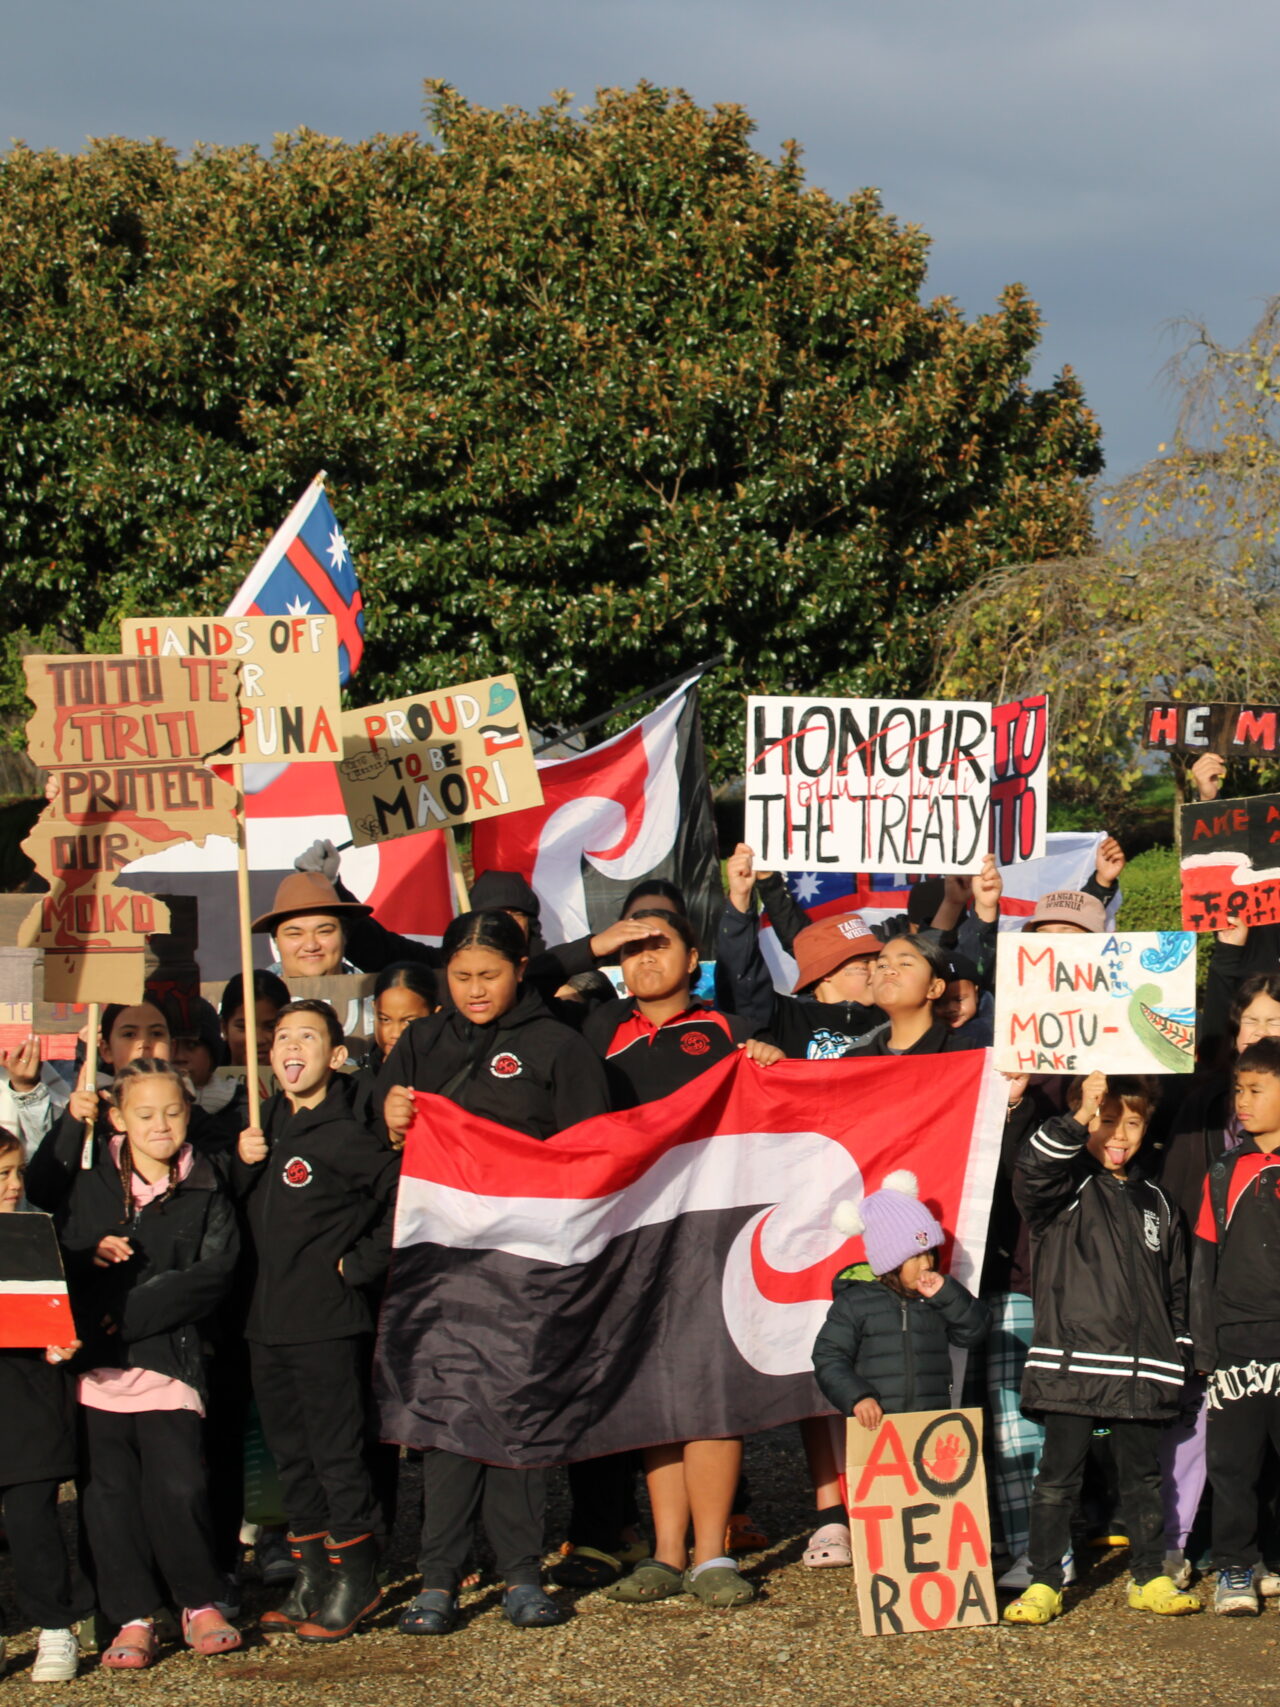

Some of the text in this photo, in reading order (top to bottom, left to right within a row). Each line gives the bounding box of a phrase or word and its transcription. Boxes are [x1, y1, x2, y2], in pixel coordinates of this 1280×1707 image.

[135, 618, 326, 656] HANDS OFF
[180, 657, 229, 701] TE
[217, 705, 338, 756] PUNA
[364, 694, 480, 752] PROUD
[753, 706, 987, 783] HONOUR
[1150, 707, 1211, 746] HE
[389, 753, 421, 780] TO
[428, 743, 461, 772] BE
[61, 765, 217, 814] PROTECT
[749, 794, 990, 866] THE TREATY
[1192, 809, 1249, 840] AKE
[51, 833, 132, 872] OUR
[41, 894, 155, 934] MOKO
[1046, 892, 1084, 904] TANGATA
[1017, 945, 1110, 992] MANA
[1017, 1050, 1077, 1070] HAKE
[854, 1412, 978, 1502] AO
[850, 1501, 988, 1574] TEA
[871, 1571, 991, 1635] ROA
